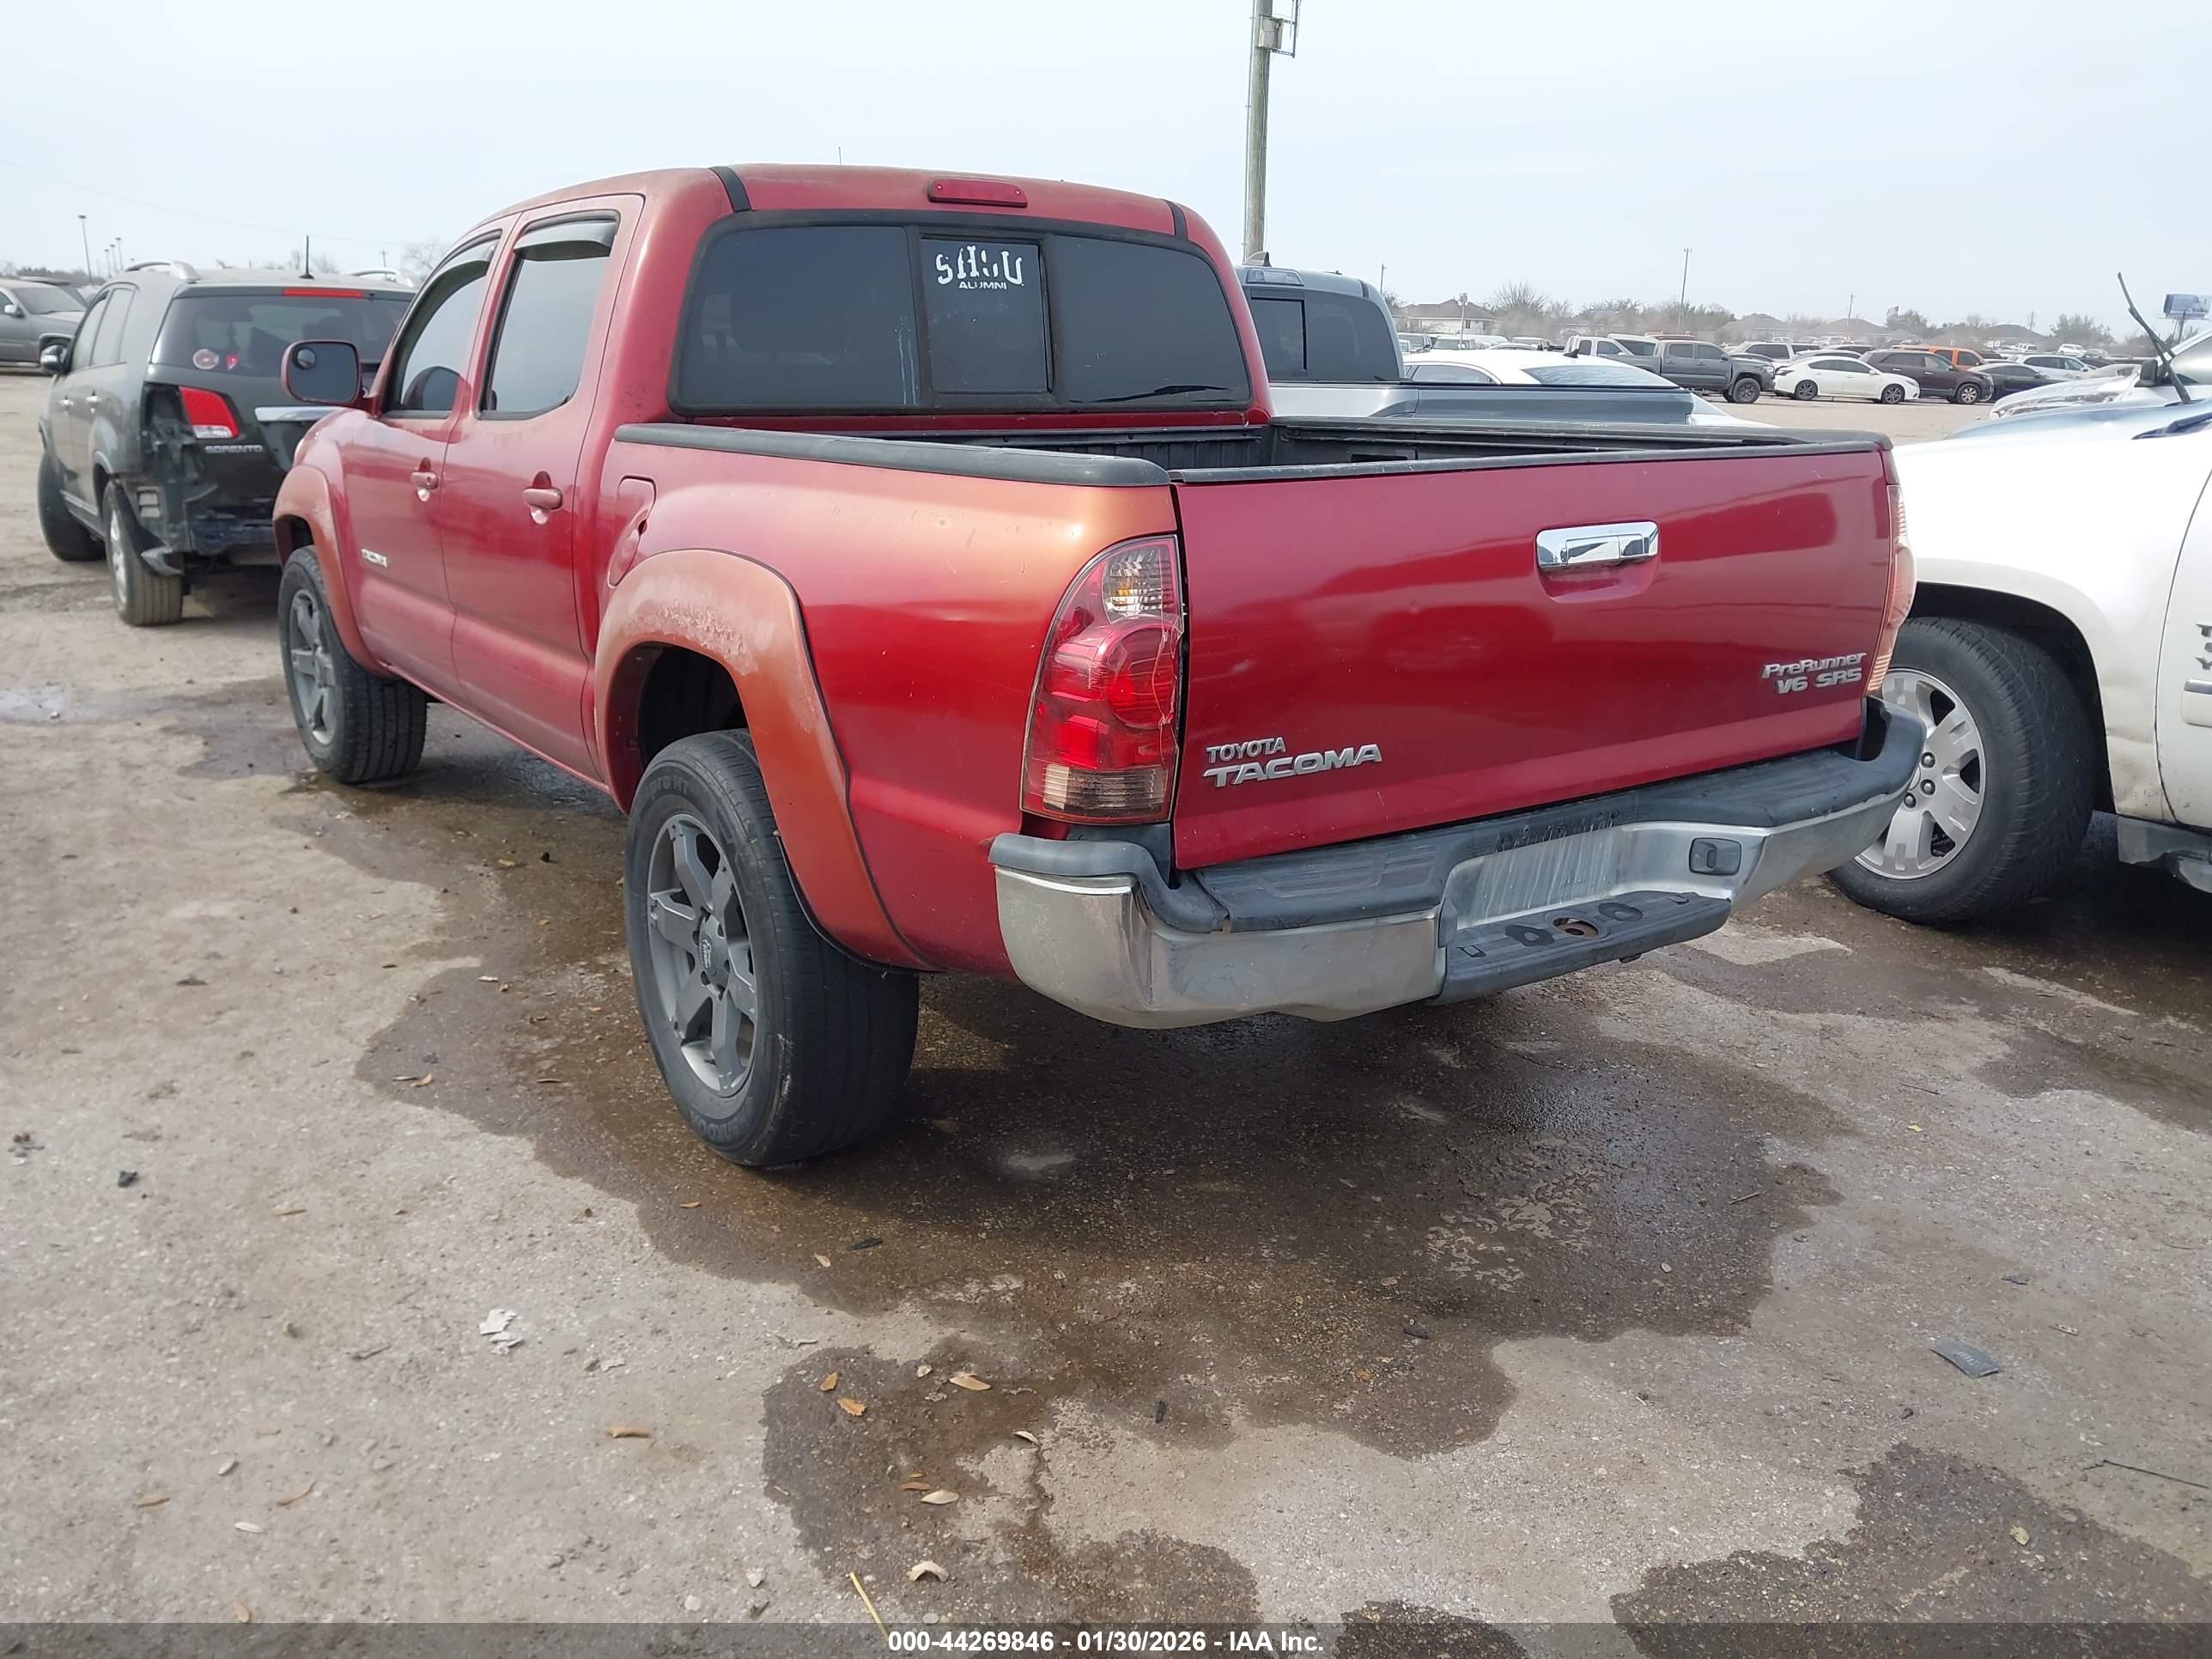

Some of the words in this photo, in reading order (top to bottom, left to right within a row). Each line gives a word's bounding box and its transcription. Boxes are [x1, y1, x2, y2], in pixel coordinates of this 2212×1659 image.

[958, 281, 1007, 290] ALUMNI
[204, 444, 263, 454] SORENTO
[1761, 653, 1868, 679] PreRunner
[1775, 676, 1808, 694] V6
[1814, 667, 1863, 688] SR5
[1206, 736, 1286, 763] TOYOTA
[1202, 744, 1382, 787] TACOMA
